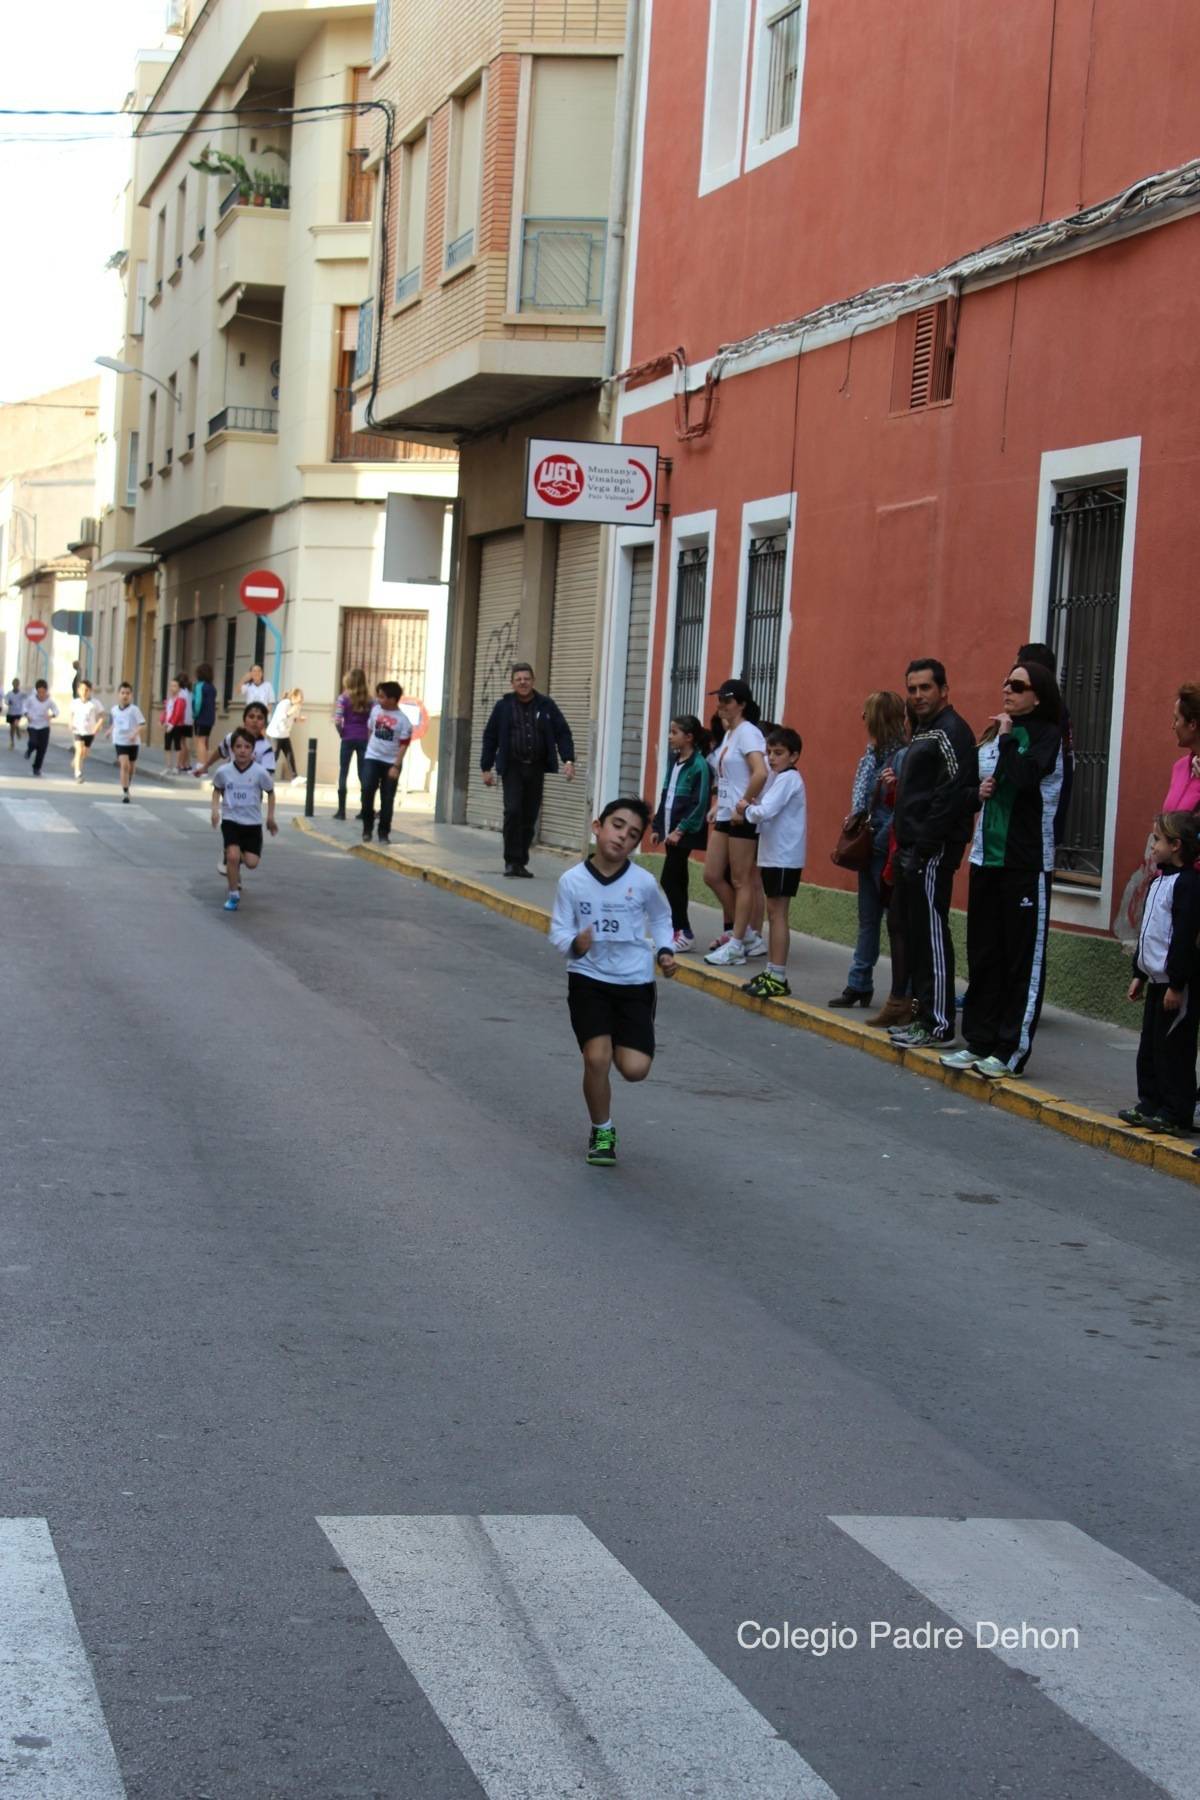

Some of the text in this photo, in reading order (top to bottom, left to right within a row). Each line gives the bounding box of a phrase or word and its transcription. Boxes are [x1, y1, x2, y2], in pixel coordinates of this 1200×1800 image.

[540, 462, 578, 483] UGT
[588, 466, 638, 476] Muntanya
[587, 484, 635, 495] Vega Baja
[592, 919, 620, 933] 129
